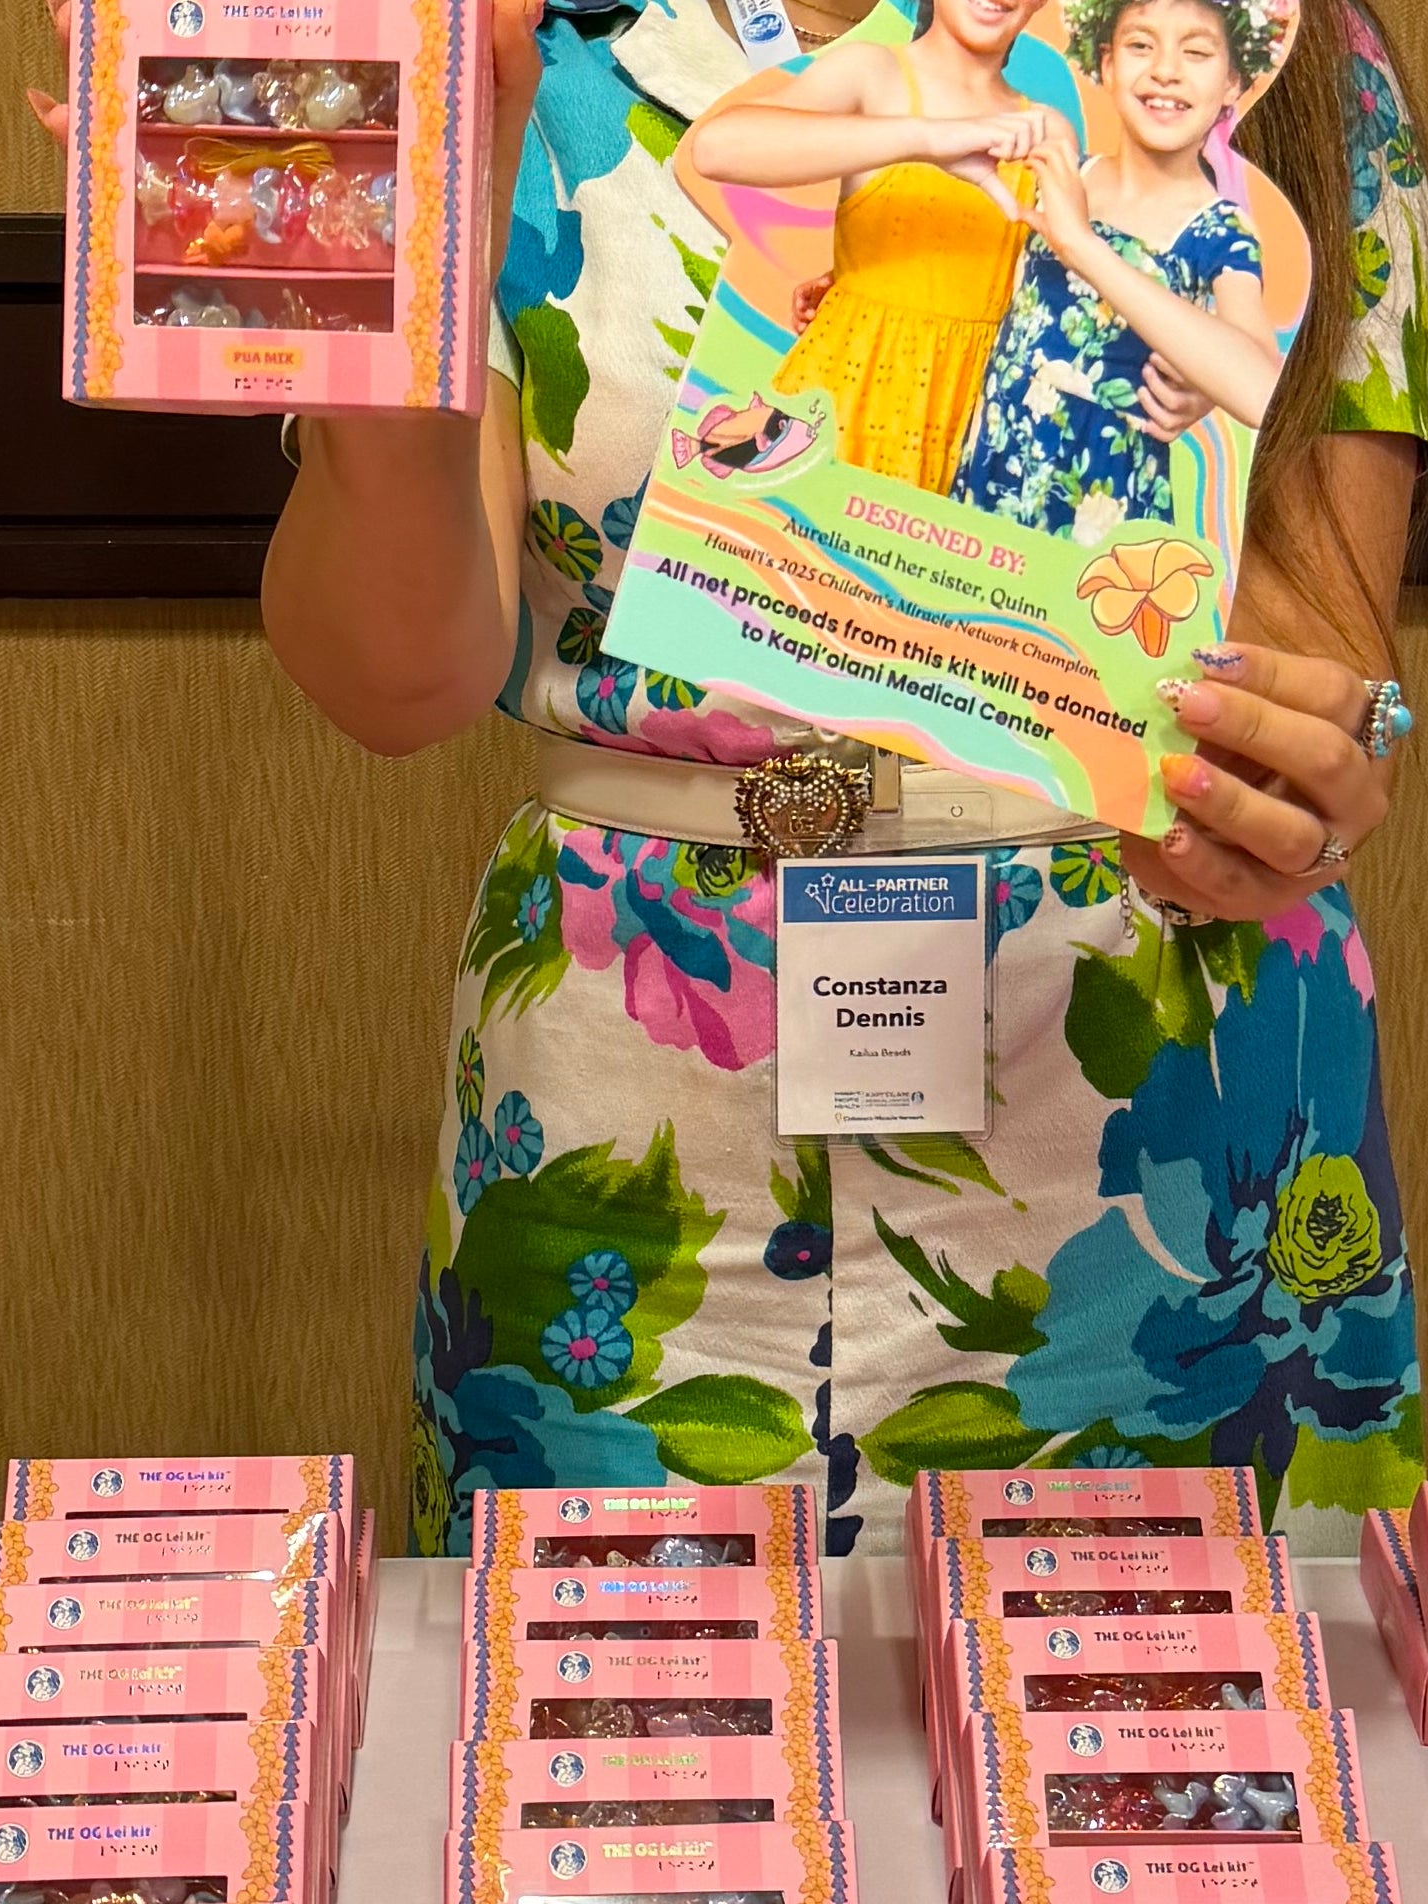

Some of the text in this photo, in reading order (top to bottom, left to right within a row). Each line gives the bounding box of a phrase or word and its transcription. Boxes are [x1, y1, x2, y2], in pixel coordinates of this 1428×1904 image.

[234, 351, 294, 364] PUA MIX
[845, 496, 1026, 575] DESIGNED BY:
[783, 517, 1047, 621] Aurelia and her sister, Quinn
[779, 558, 817, 582] 2025
[818, 572, 894, 610] Children's
[897, 600, 953, 629] Miracle
[955, 620, 1019, 653] Network
[656, 557, 688, 582] All
[731, 585, 839, 634] proceeds
[844, 619, 897, 654] from
[903, 641, 943, 669] this
[947, 655, 977, 681] kit
[982, 668, 1020, 695] will
[1022, 680, 1050, 705] be
[1054, 695, 1148, 739] donated
[741, 621, 763, 643] to
[886, 669, 975, 716] Medical
[980, 702, 1054, 741] Center
[838, 877, 949, 893] ALL-PARTNER
[831, 892, 954, 915] Celebration
[813, 976, 947, 996] Constanza
[836, 1006, 925, 1028] Dennis
[115, 1533, 139, 1543] THE
[143, 1533, 162, 1543] OG
[166, 1532, 184, 1542] Lei
[1118, 1728, 1145, 1739] THE
[1148, 1727, 1170, 1738] OG
[1173, 1727, 1192, 1738] Lei
[47, 1827, 75, 1840] THE
[80, 1826, 101, 1839] OG
[106, 1826, 126, 1838] Lei
